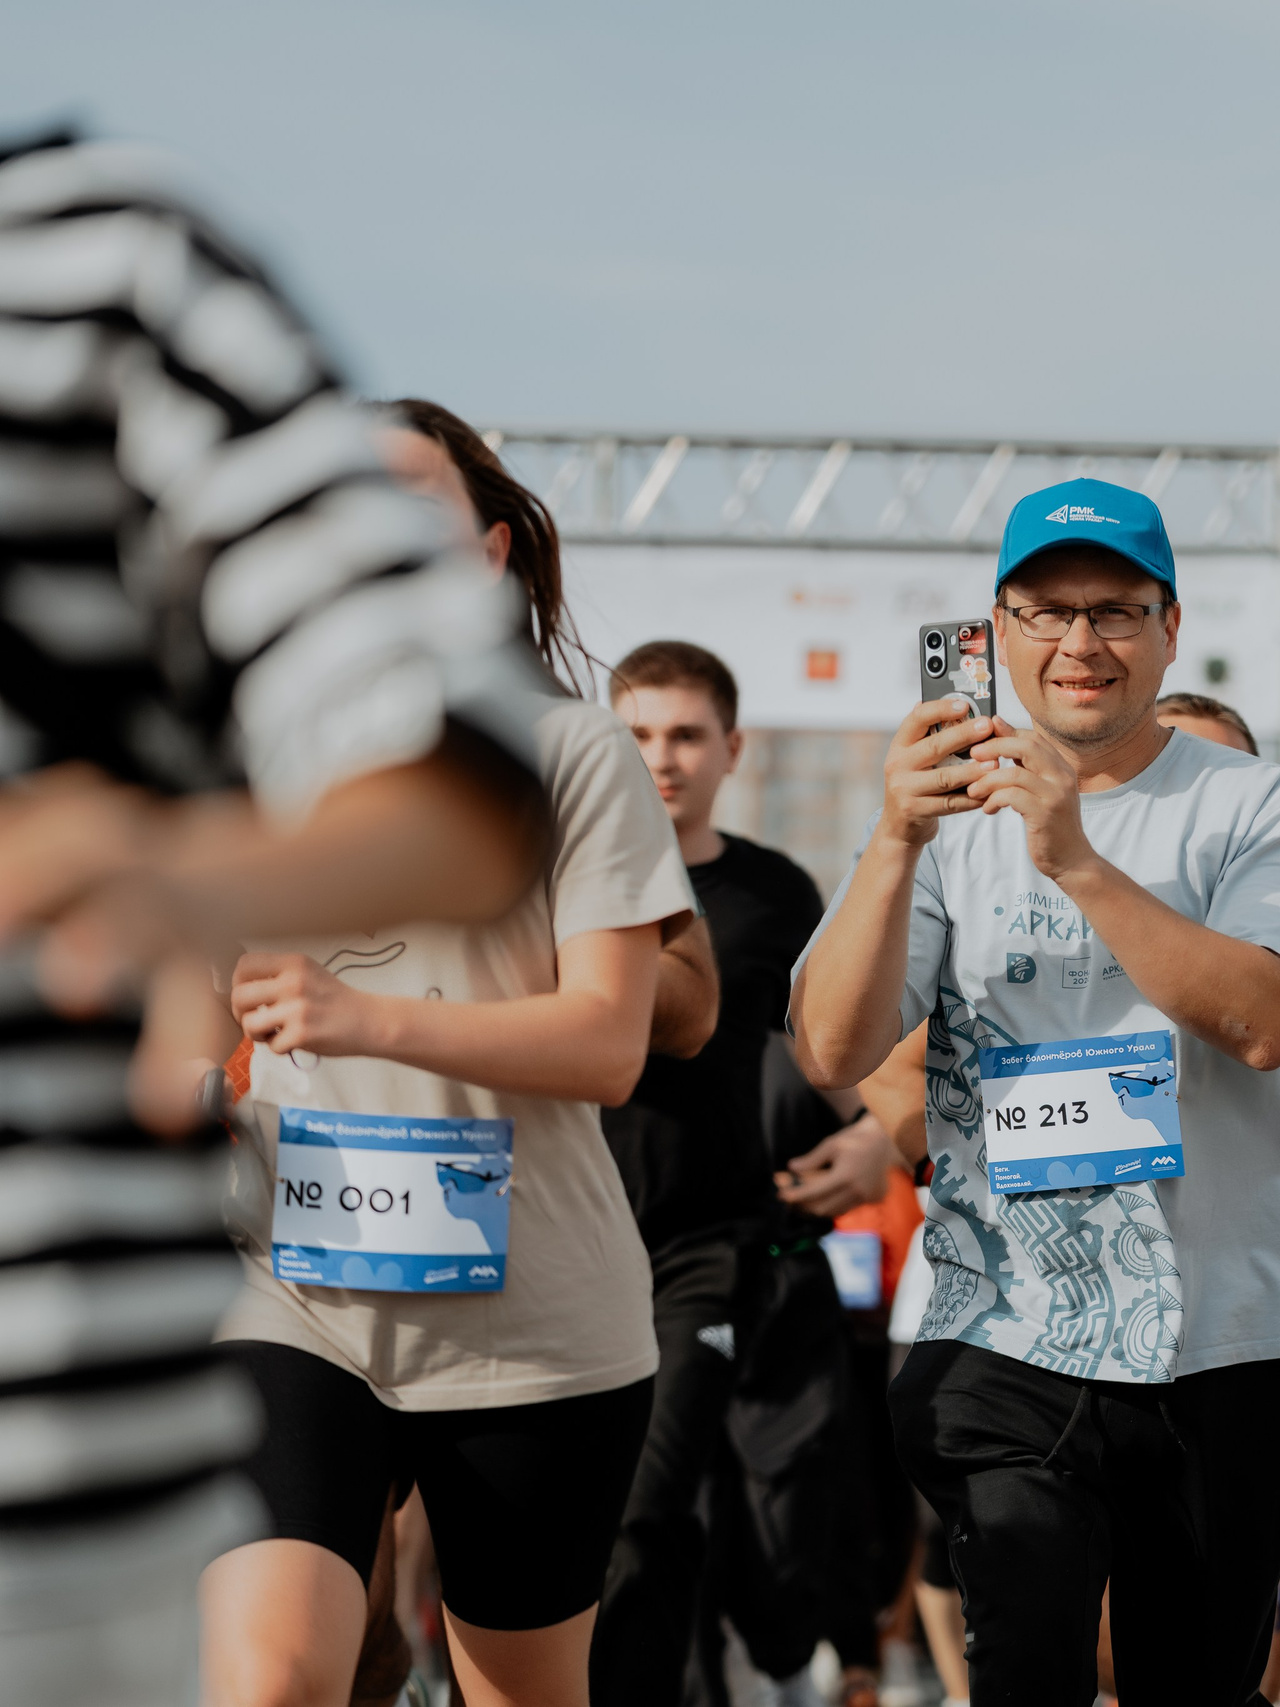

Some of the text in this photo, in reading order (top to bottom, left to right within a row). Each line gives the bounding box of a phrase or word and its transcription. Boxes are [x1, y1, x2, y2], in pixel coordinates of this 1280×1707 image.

[1070, 506, 1095, 515] РМК
[1008, 909, 1093, 941] АРКАИ
[1068, 969, 1090, 977] ФОН
[1073, 977, 1089, 985] 202
[1001, 1043, 1156, 1065] Забег волонтёров Южного Урала
[995, 1100, 1090, 1132] № 213
[995, 1173, 1022, 1181] Помогай.
[285, 1179, 411, 1215] № 001
